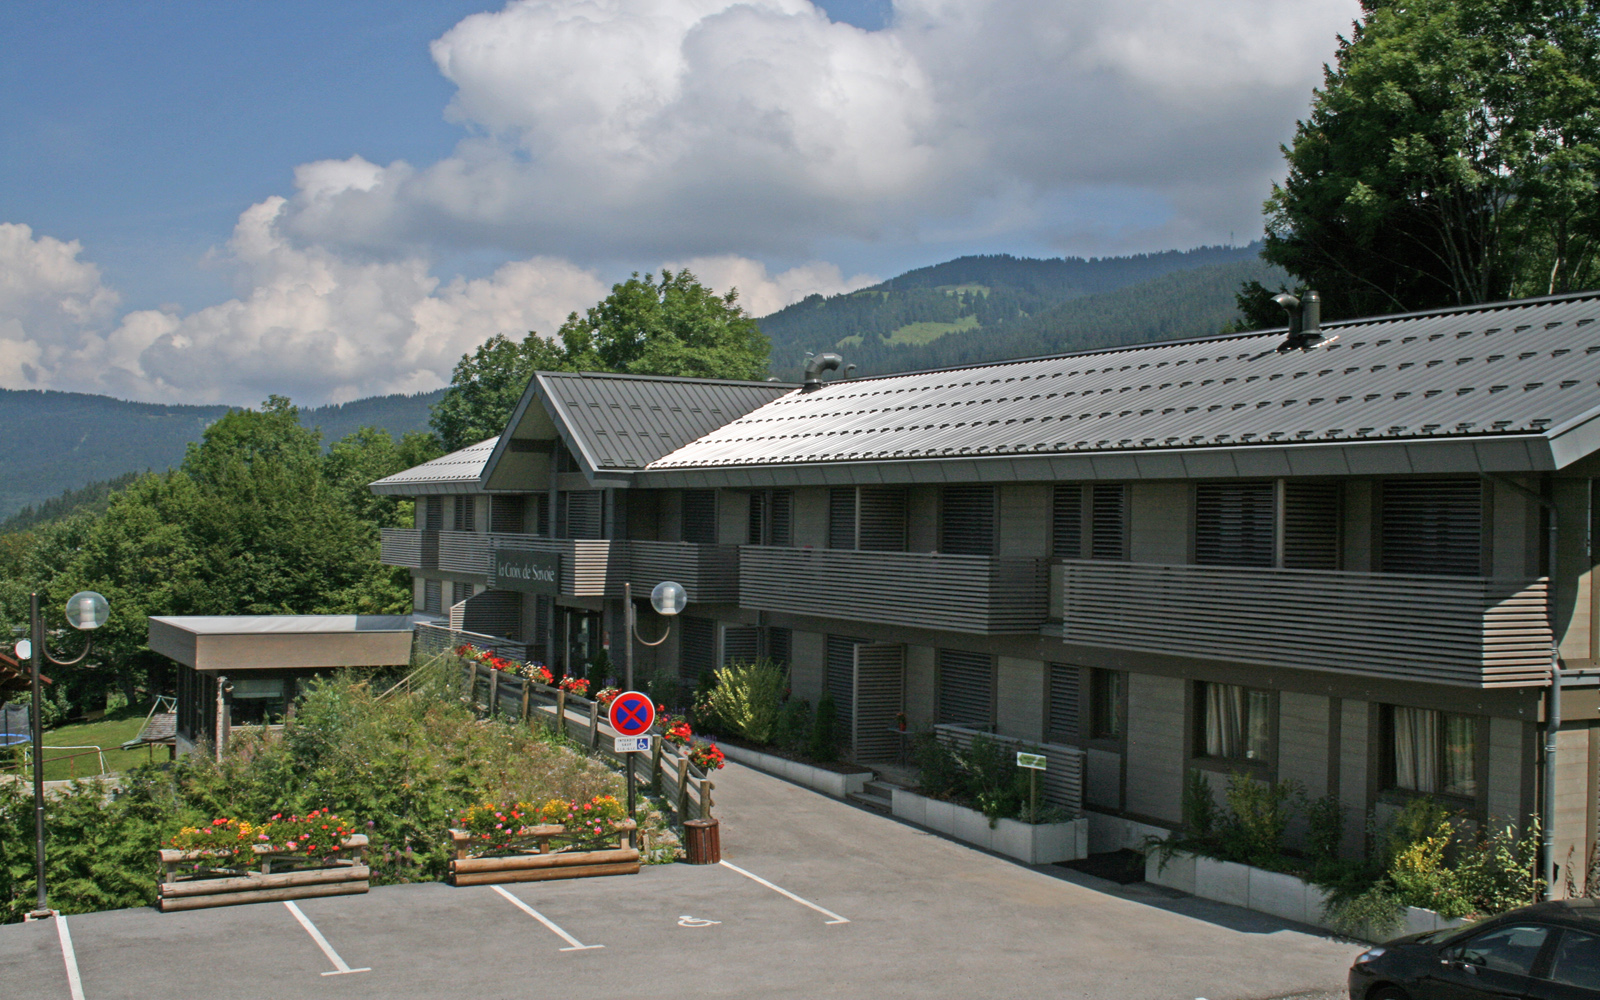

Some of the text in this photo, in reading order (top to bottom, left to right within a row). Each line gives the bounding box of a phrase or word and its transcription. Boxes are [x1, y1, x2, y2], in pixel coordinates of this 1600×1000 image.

[505, 562, 521, 578] Croix
[522, 564, 530, 579] de
[532, 564, 554, 582] Savoie
